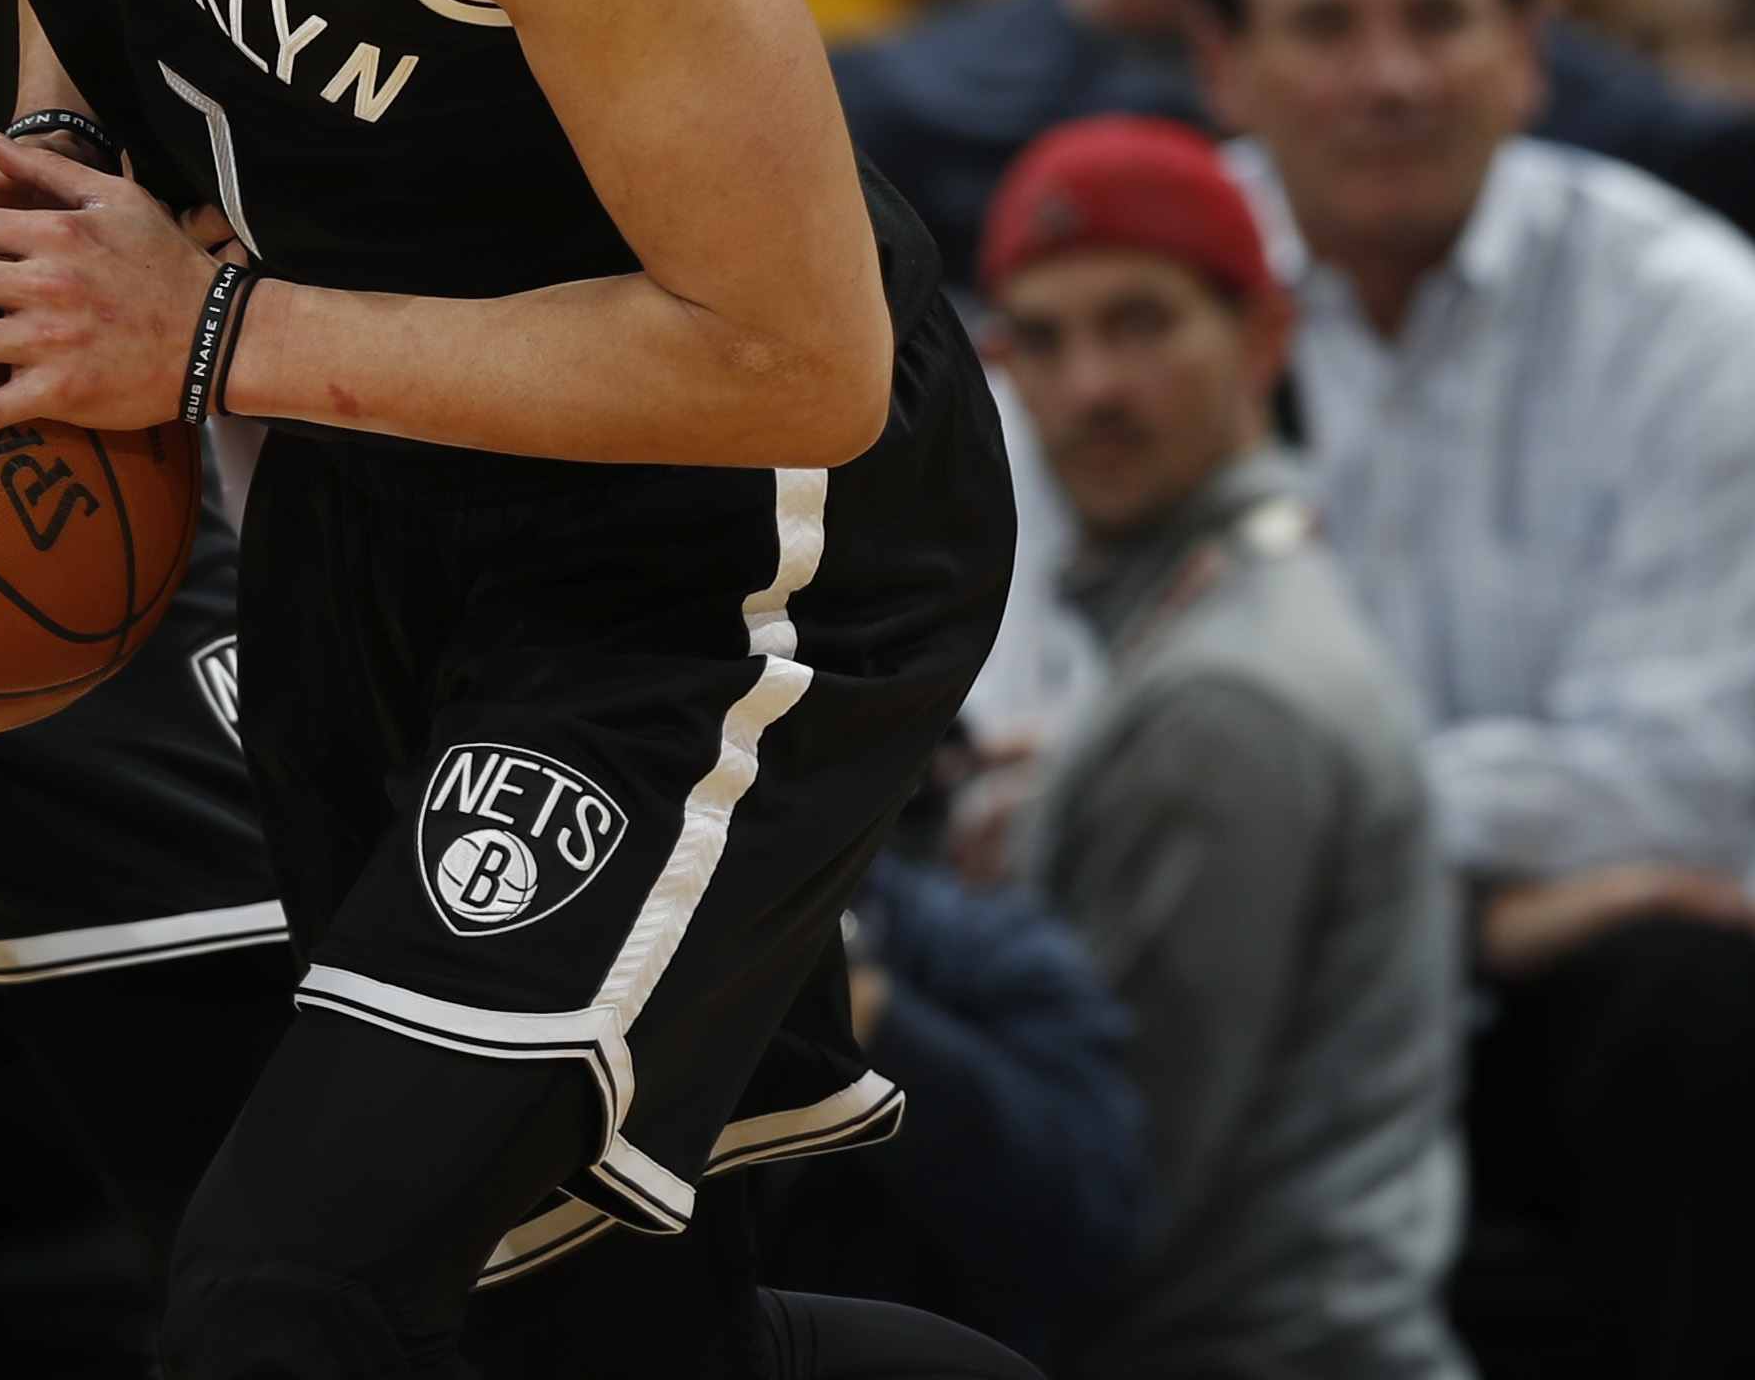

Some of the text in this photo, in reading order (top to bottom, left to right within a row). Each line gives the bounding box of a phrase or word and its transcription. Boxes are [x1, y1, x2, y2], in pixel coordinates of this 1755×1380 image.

[193, 319, 218, 378] NAME
[430, 752, 613, 873] NETS
[459, 840, 513, 910] B
